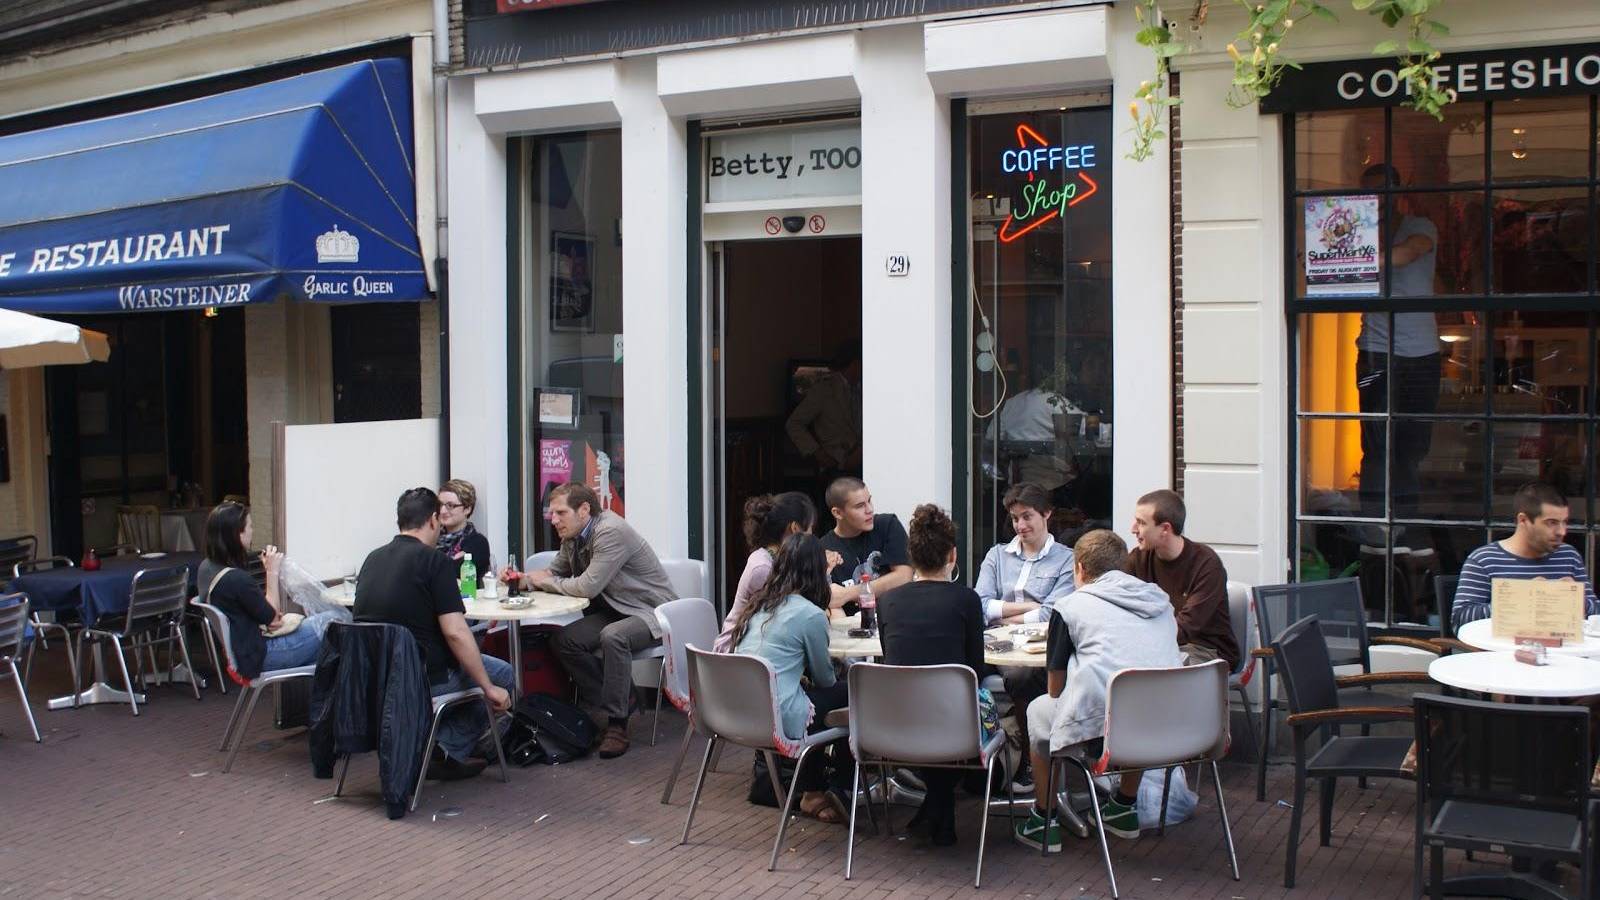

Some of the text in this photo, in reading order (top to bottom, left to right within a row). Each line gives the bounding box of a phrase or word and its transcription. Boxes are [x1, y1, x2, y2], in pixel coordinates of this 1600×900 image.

[1003, 146, 1095, 172] COFFEE
[1014, 180, 1076, 219] Shop
[28, 224, 230, 274] RESTAURANT
[890, 256, 905, 272] 29
[119, 283, 251, 309] WARSTEINER
[304, 274, 394, 299] GARLIC QUEEN
